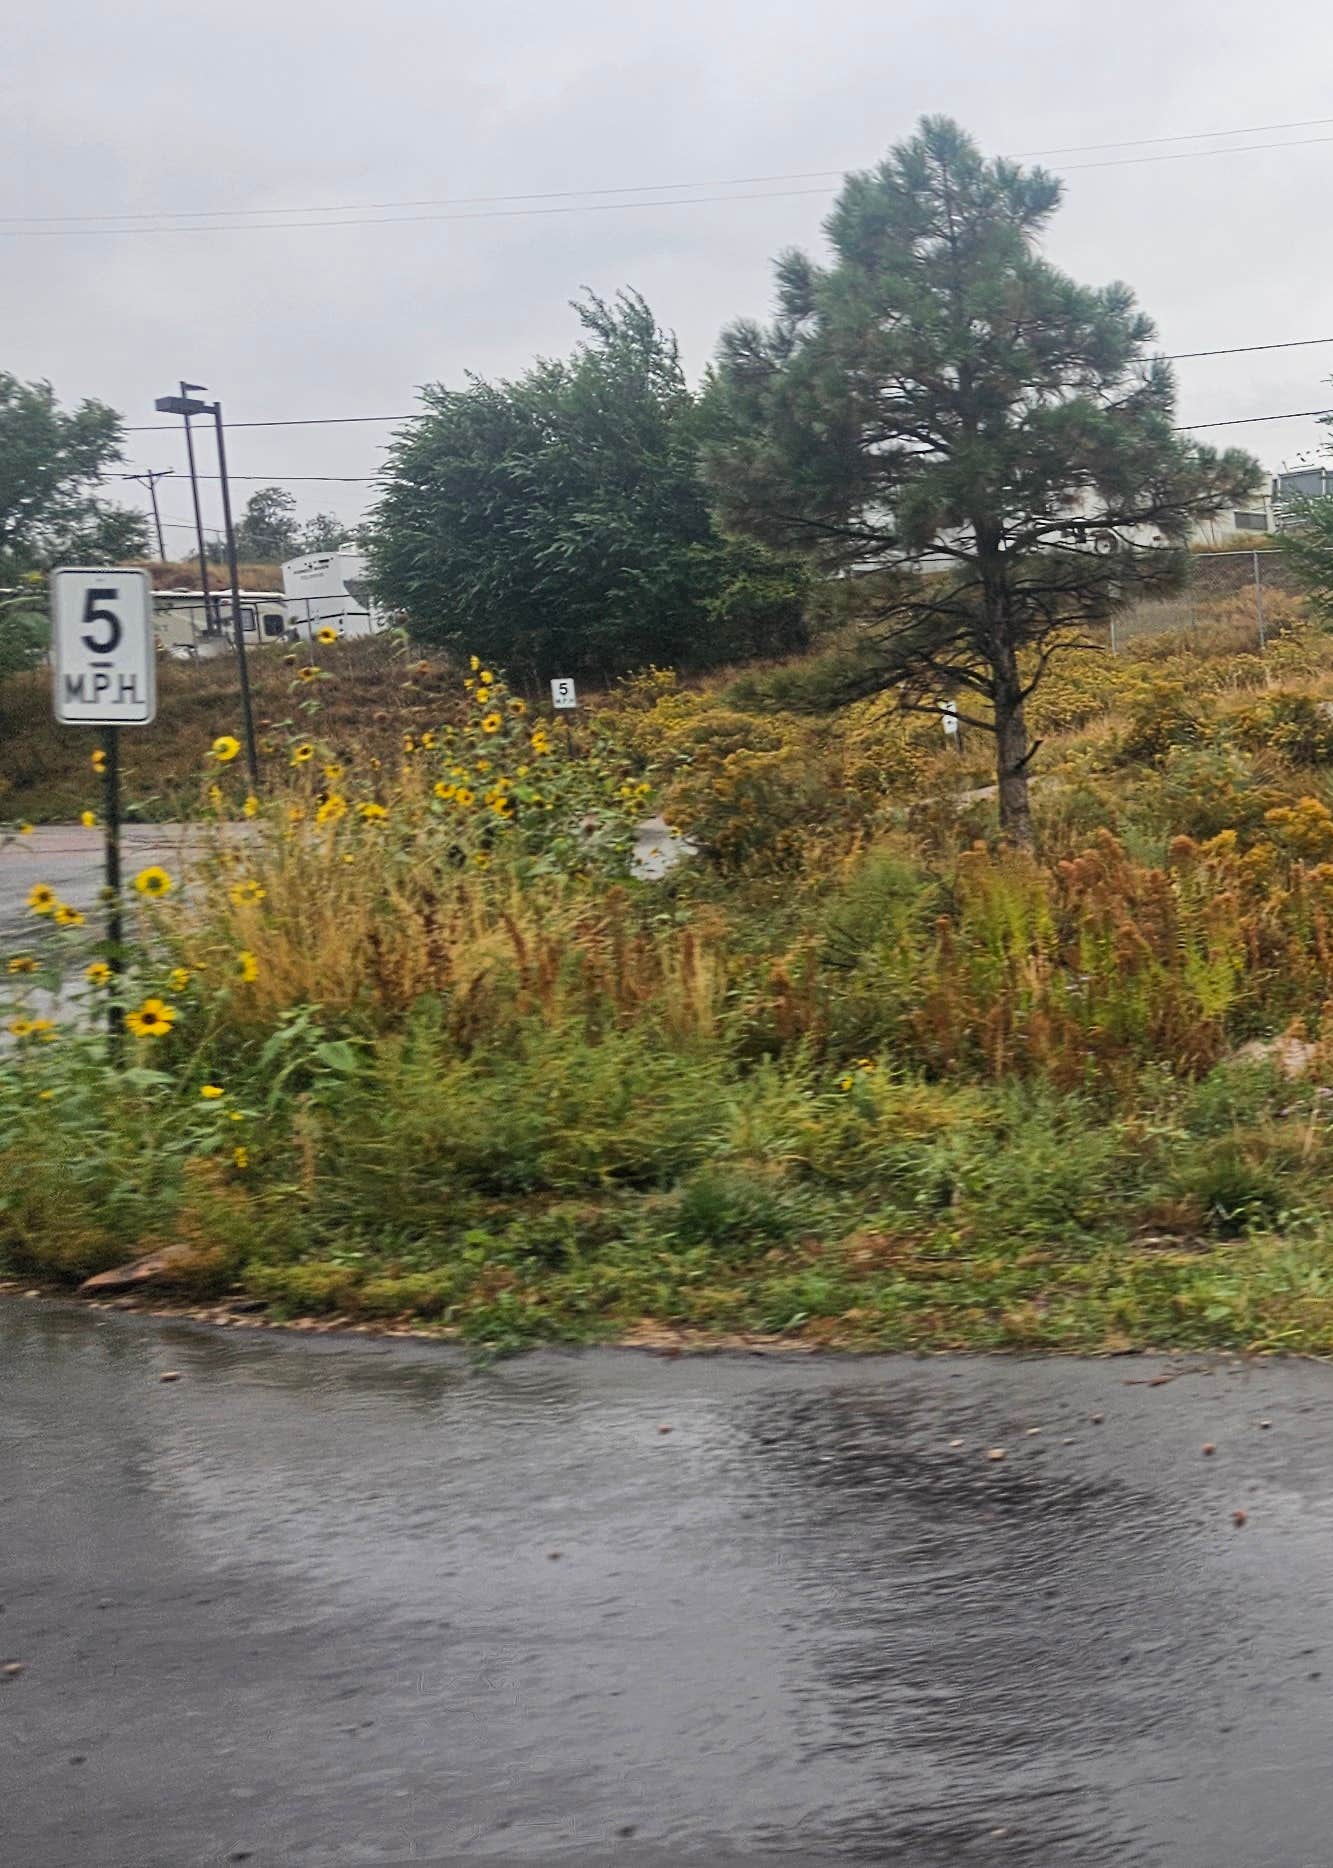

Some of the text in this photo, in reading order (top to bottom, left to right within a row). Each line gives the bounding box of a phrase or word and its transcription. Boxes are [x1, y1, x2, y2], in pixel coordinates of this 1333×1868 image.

[80, 587, 122, 654] 5
[63, 673, 145, 704] M.P.H.
[559, 682, 568, 695] 5
